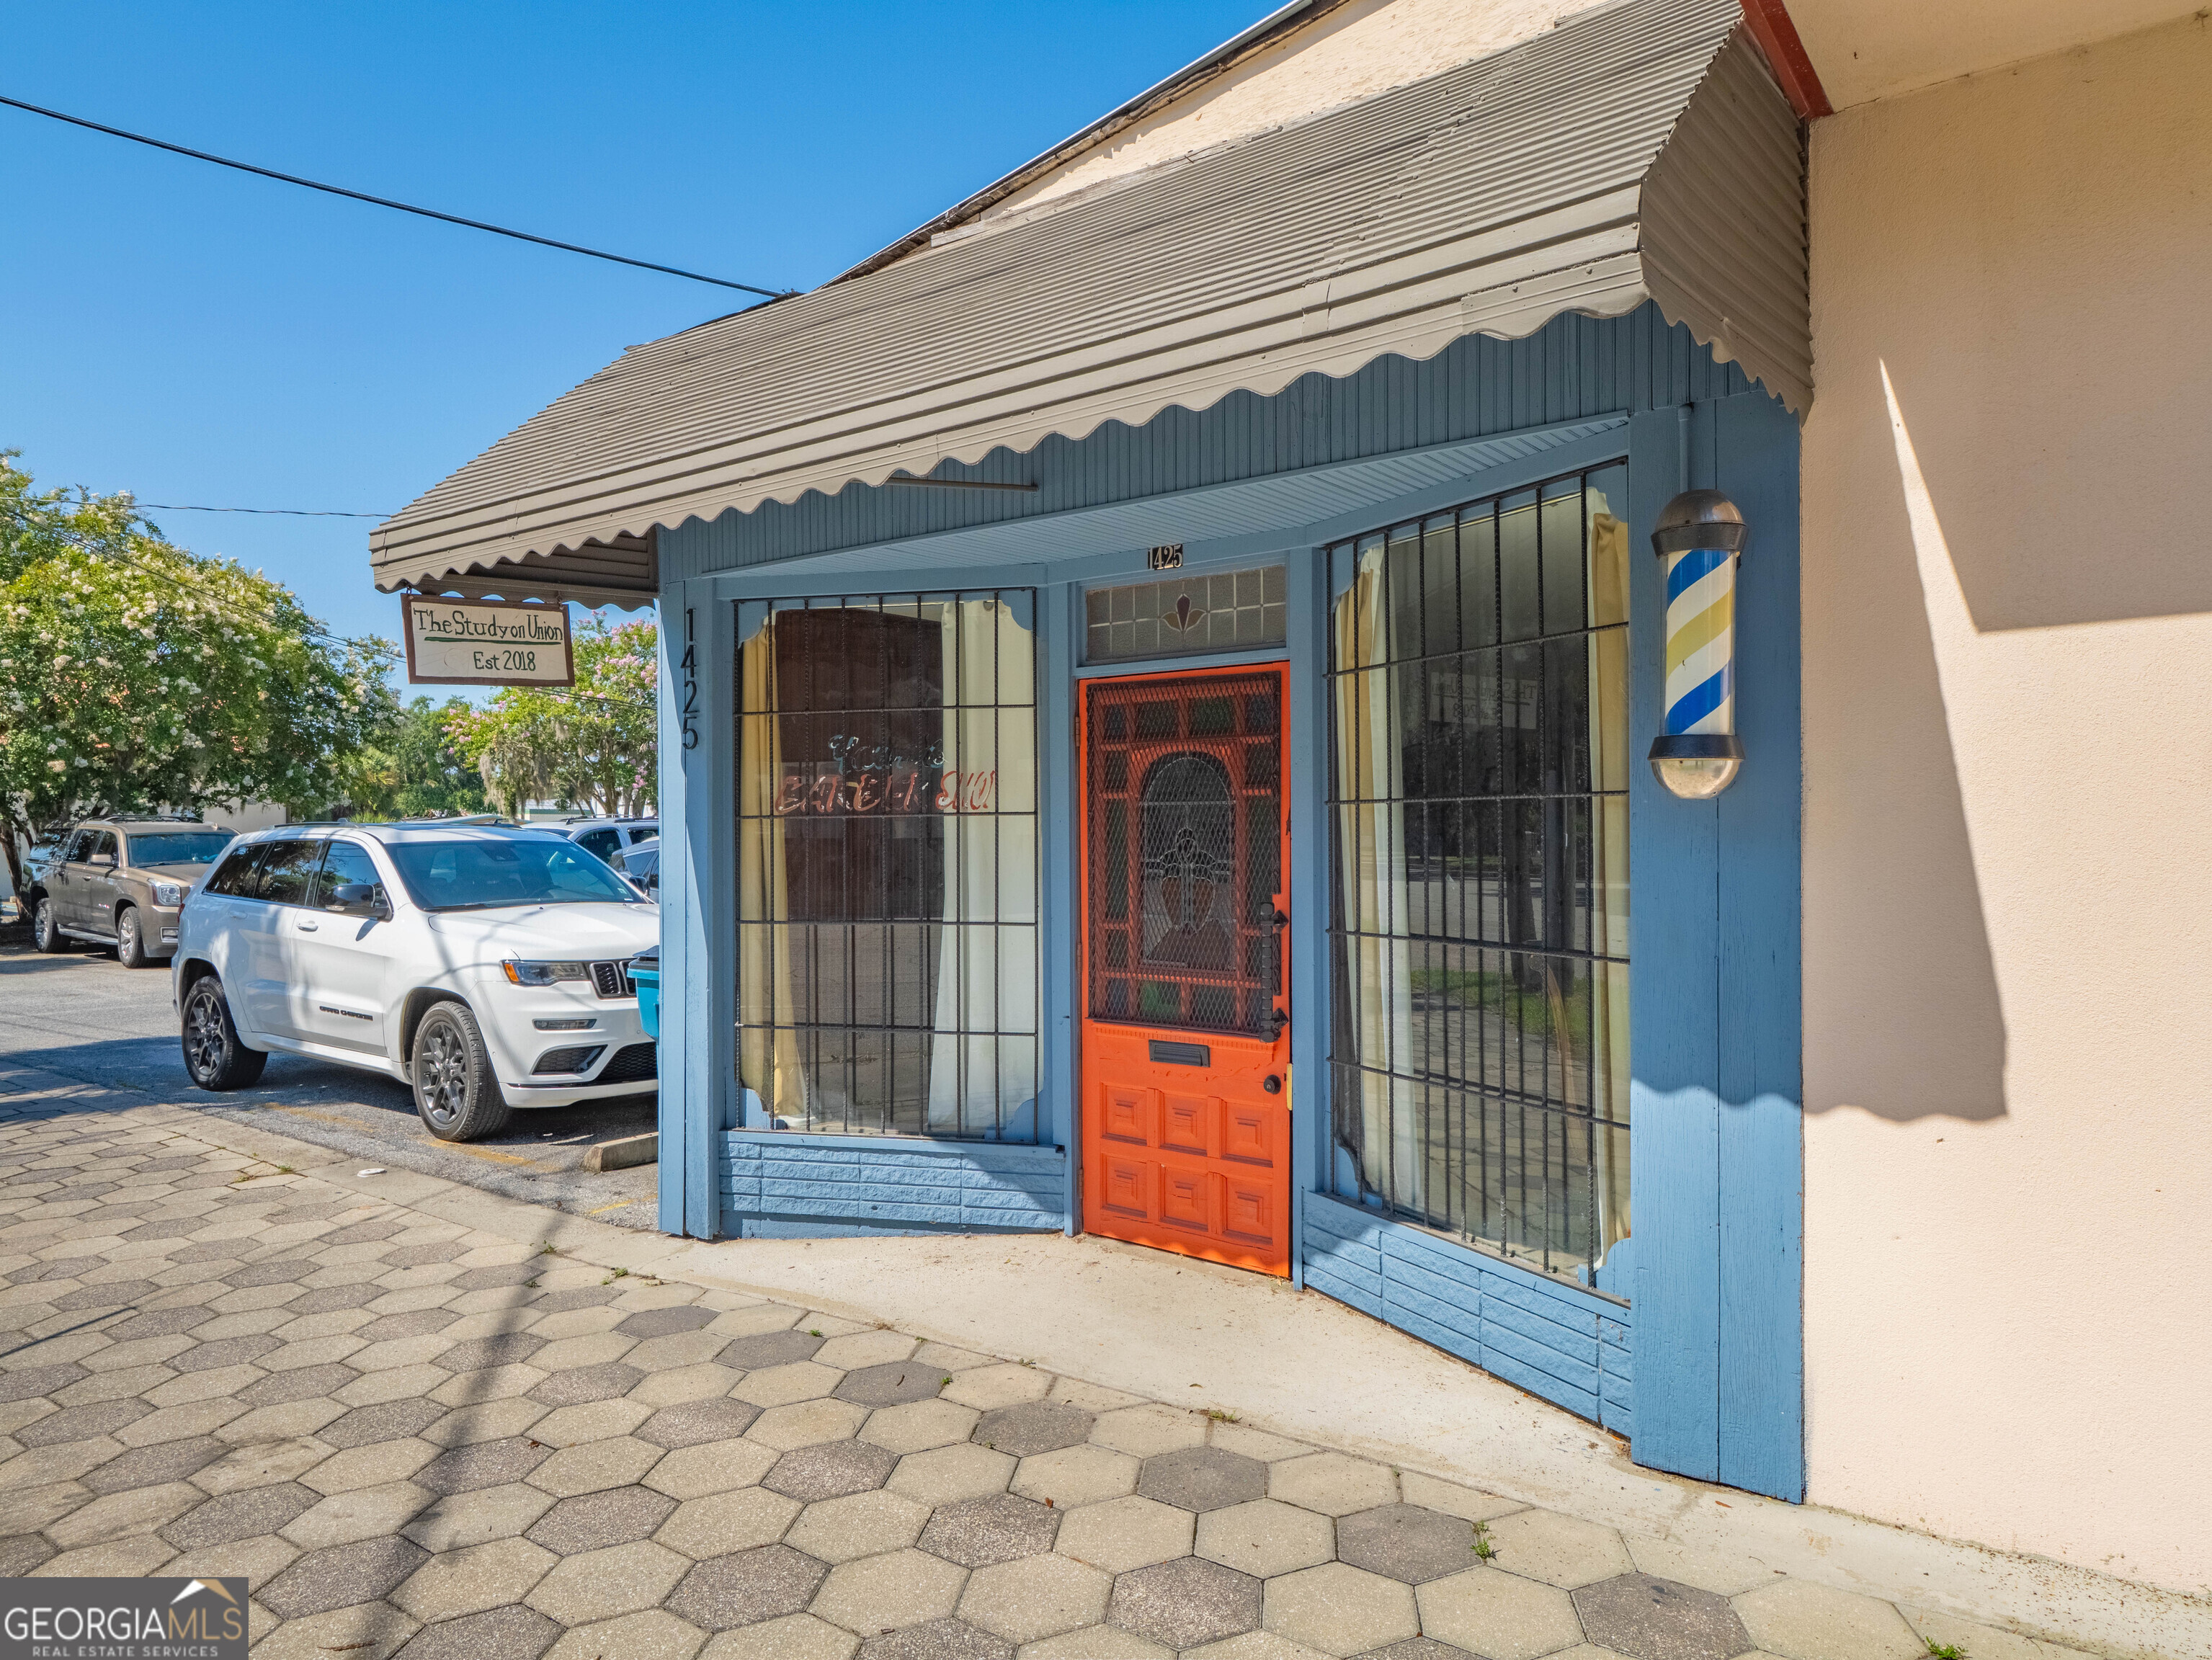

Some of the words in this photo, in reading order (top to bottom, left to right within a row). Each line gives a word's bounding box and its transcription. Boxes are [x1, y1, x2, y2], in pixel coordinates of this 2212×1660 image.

[1149, 544, 1182, 570] 1425
[414, 607, 452, 634] The
[452, 610, 511, 640] Study
[510, 622, 525, 638] on
[527, 615, 563, 641] Union
[473, 651, 500, 671] Est
[502, 650, 536, 671] 2018
[680, 608, 698, 750] 1425
